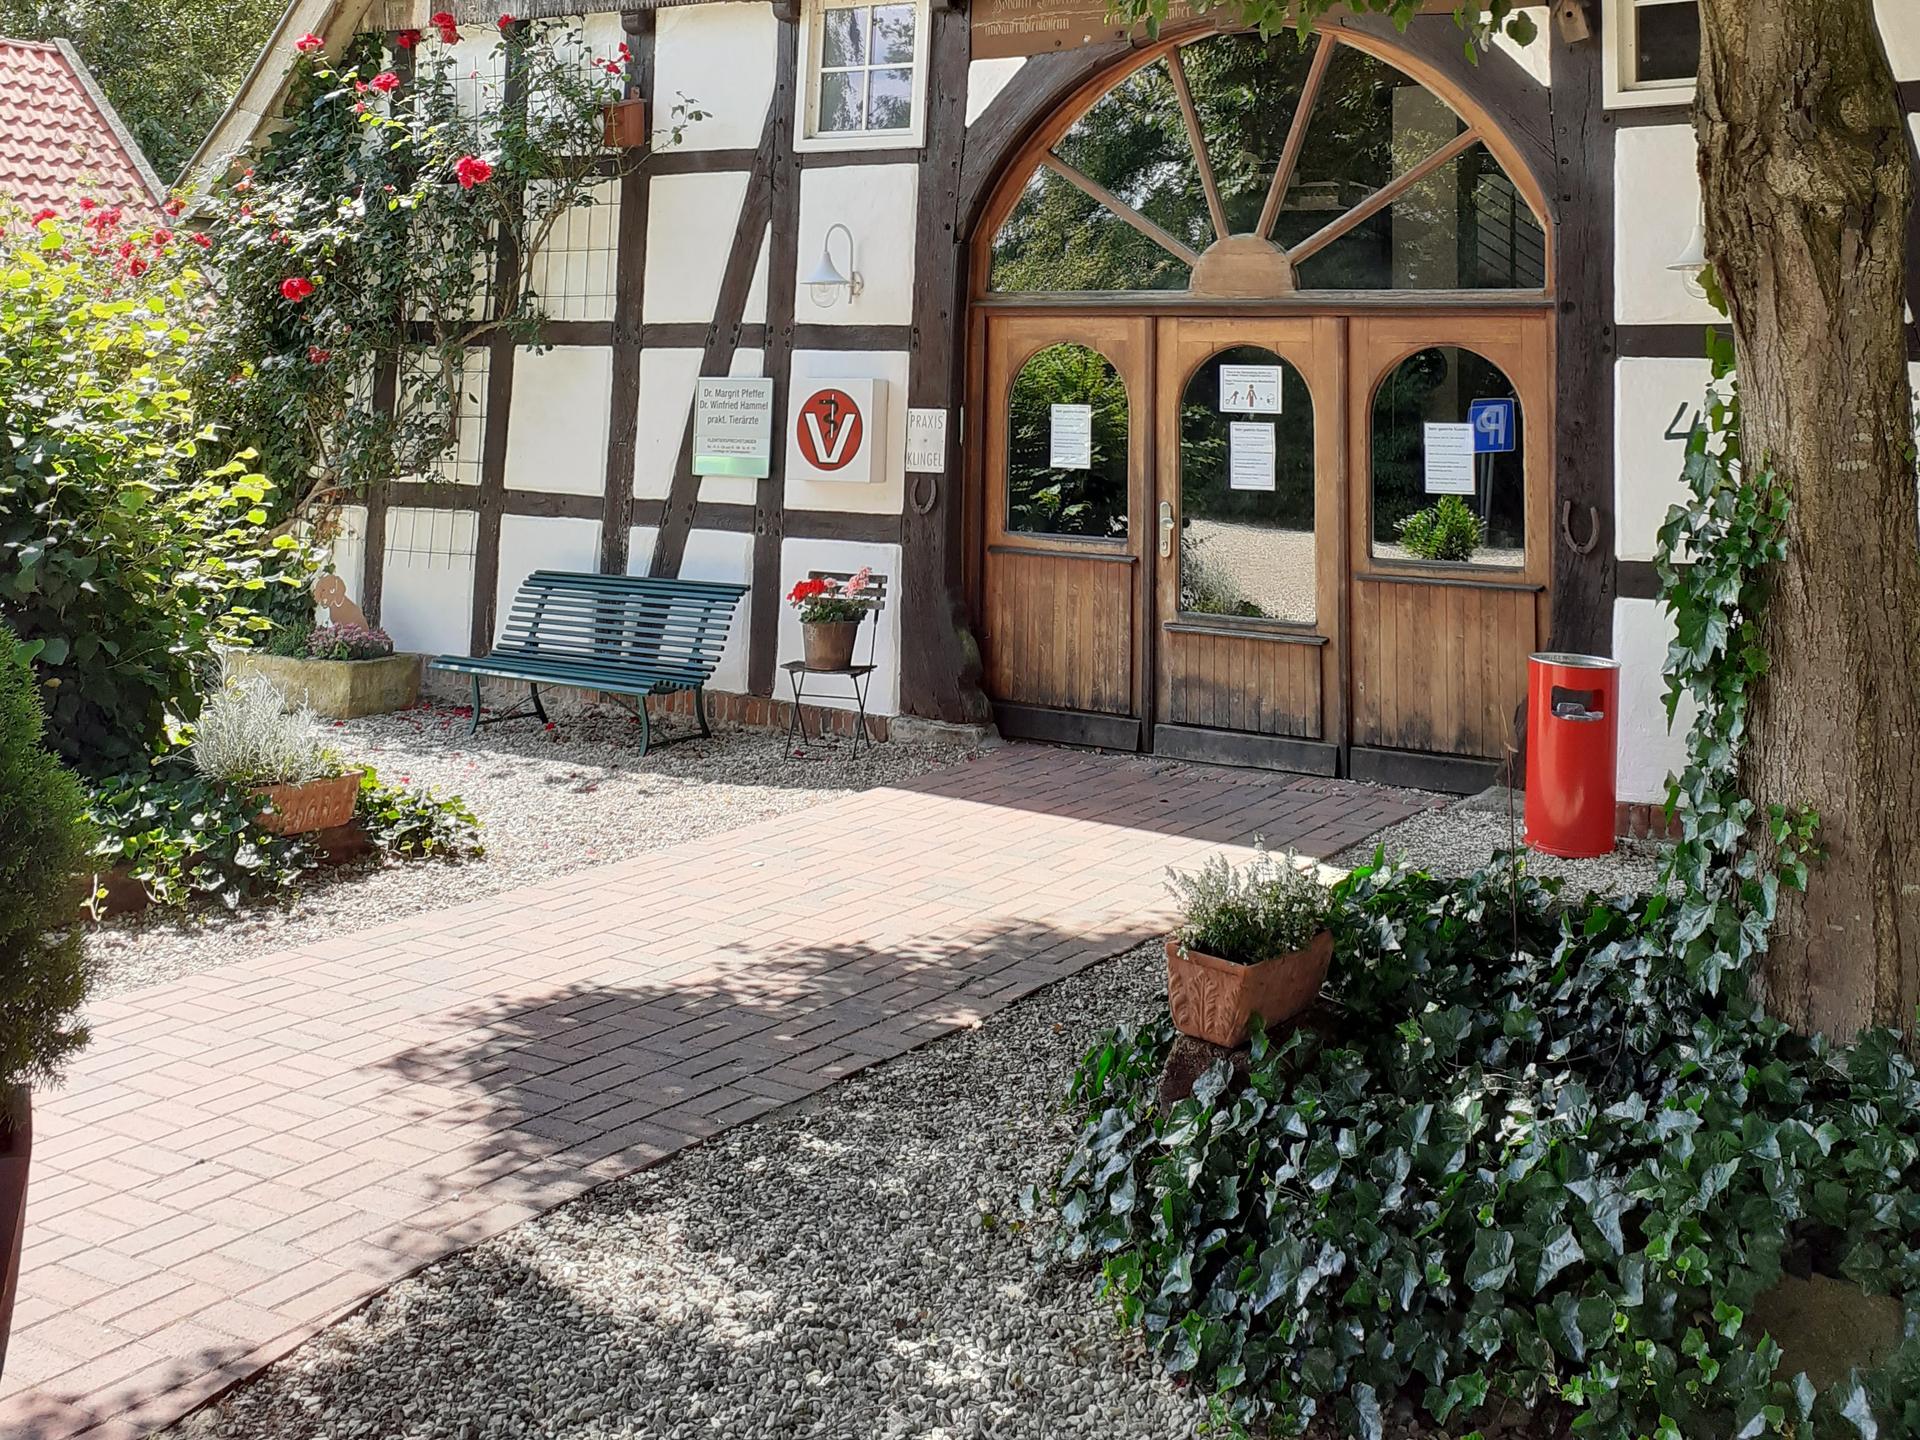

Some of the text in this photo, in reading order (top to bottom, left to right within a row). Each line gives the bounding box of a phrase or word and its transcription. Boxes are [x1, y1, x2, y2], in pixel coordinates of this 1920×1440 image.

[704, 388, 765, 399] Dr. Margrit Pfeffer
[699, 400, 769, 410] Dr. Winfried Hammel
[707, 415, 759, 425] prakt. Tierärzte
[909, 414, 943, 430] PRAXIS
[906, 451, 943, 467] KLINGEL
